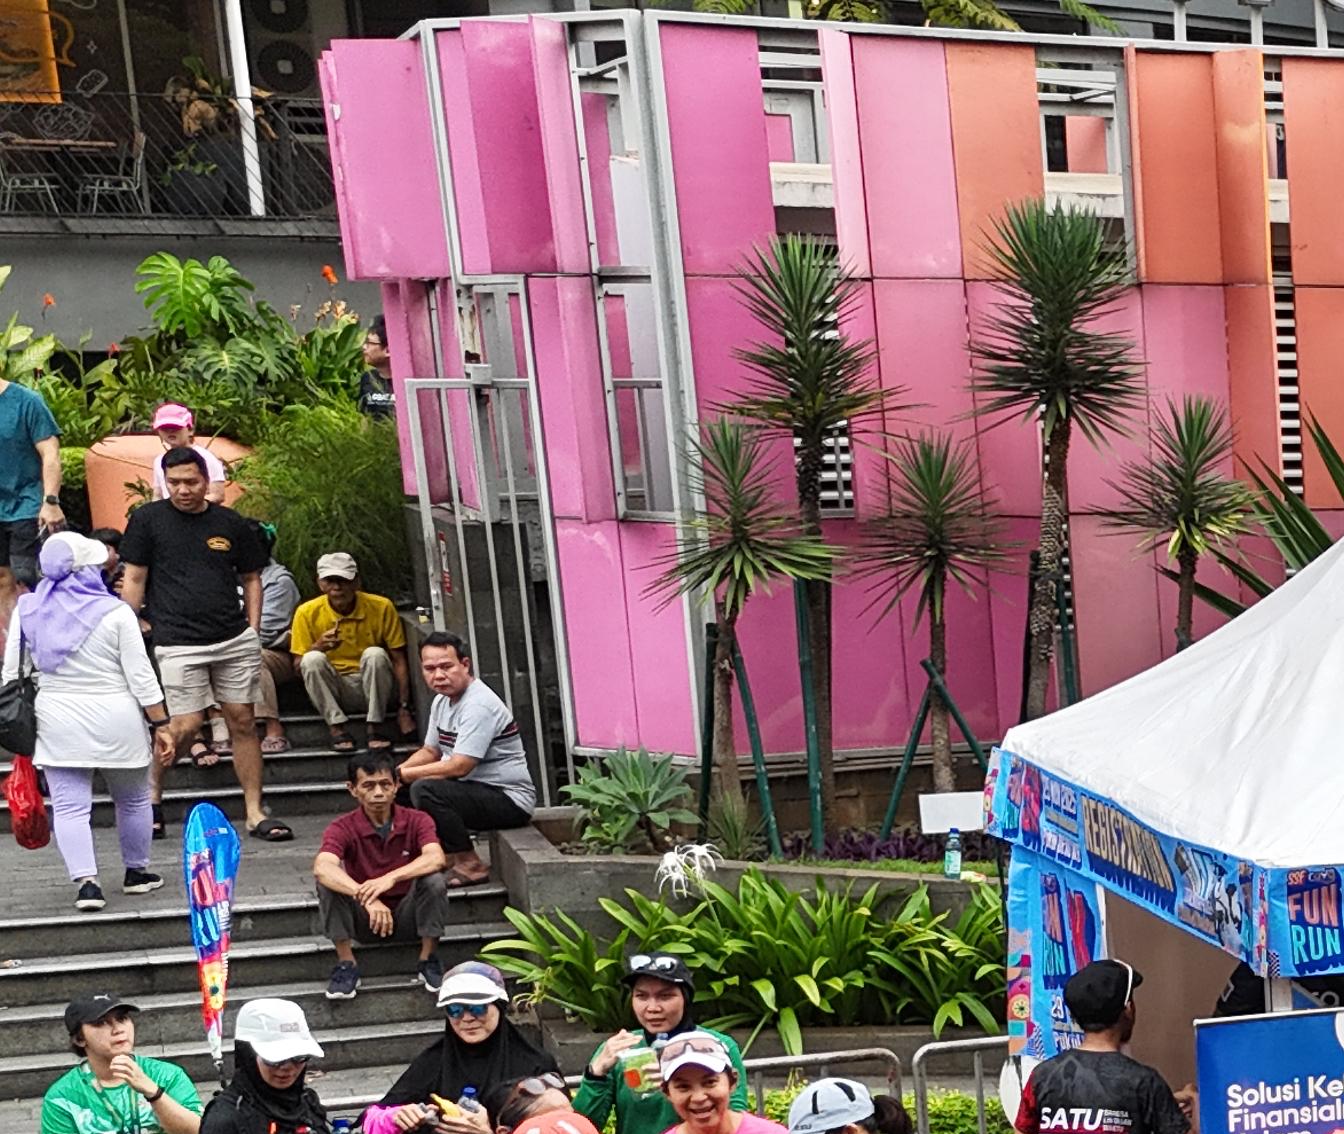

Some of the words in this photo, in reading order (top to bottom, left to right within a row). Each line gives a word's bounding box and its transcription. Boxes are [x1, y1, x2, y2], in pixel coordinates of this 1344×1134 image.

[1288, 884, 1338, 925] FUN
[1290, 925, 1341, 965] RUN
[1227, 1078, 1300, 1109] Solusi
[1040, 1107, 1104, 1131] SATU
